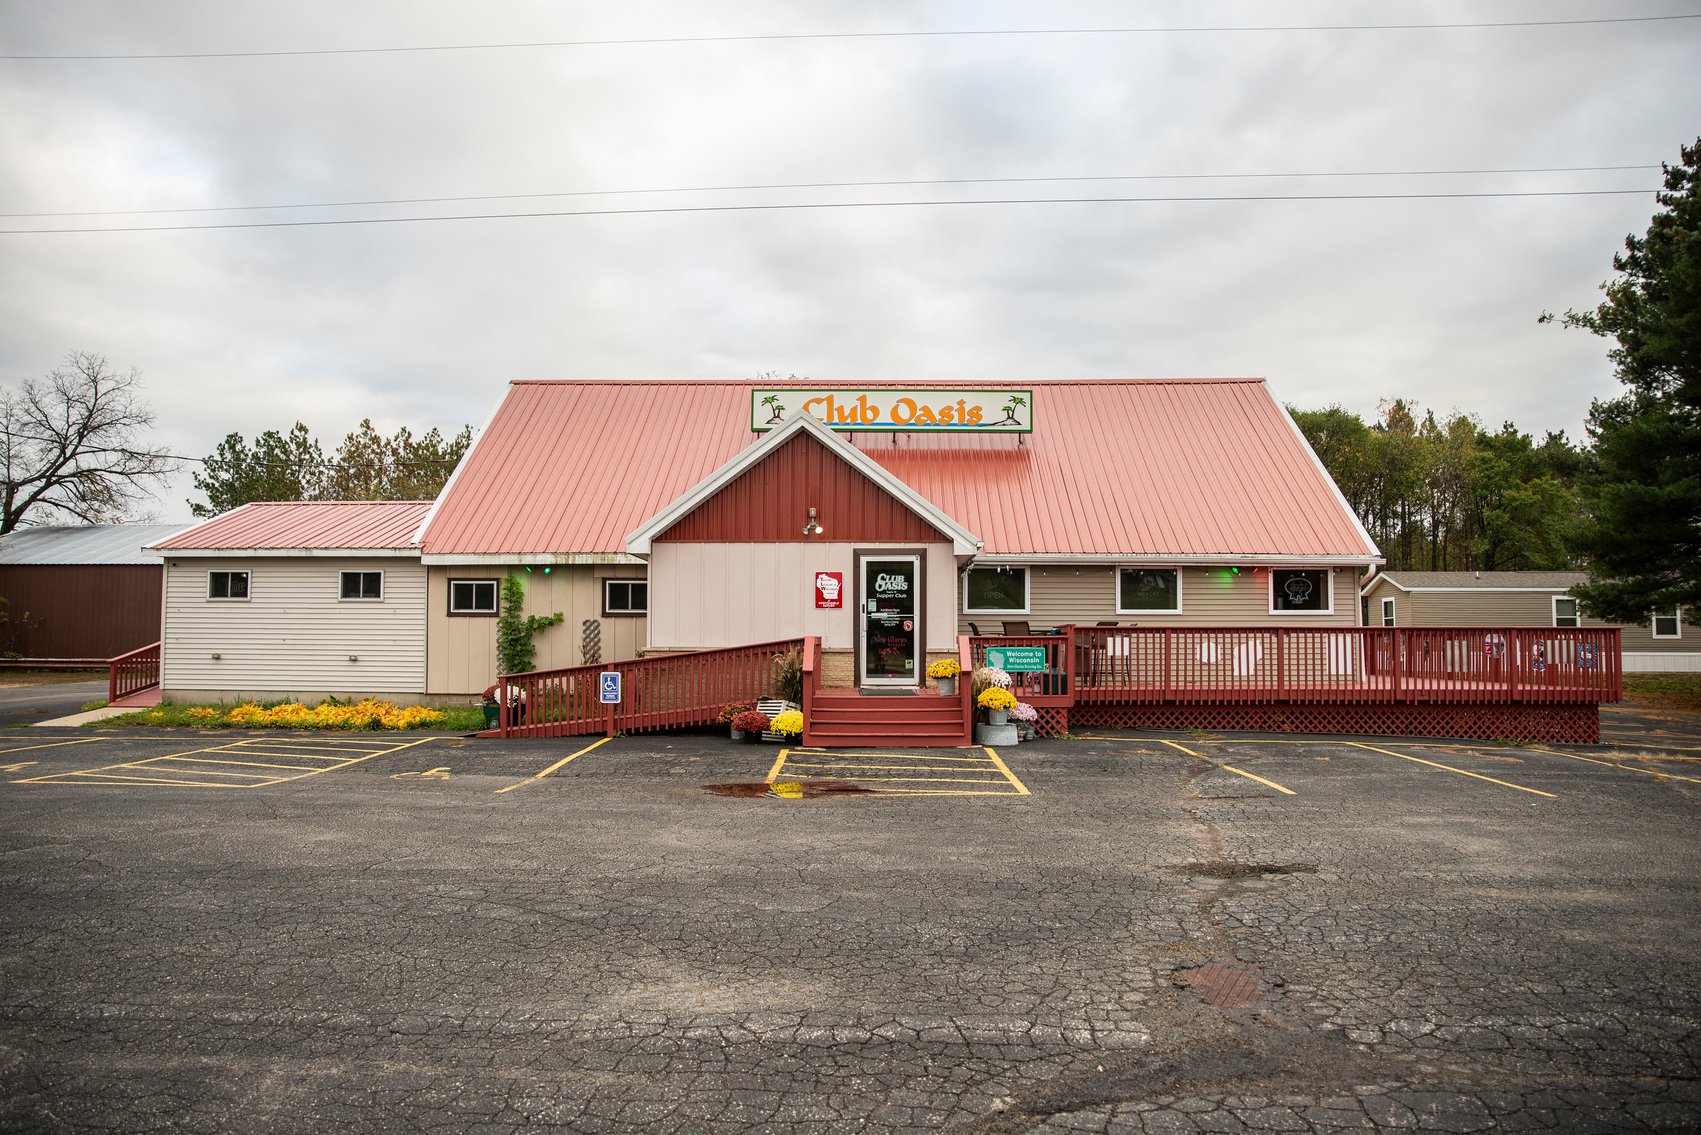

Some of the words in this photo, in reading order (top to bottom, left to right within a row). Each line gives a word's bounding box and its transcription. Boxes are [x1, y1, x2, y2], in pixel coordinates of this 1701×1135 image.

[802, 394, 880, 425] Club
[890, 397, 984, 426] Oasis
[877, 573, 905, 584] CLUB
[875, 581, 909, 592] OASIS
[984, 592, 1004, 600] OPEN
